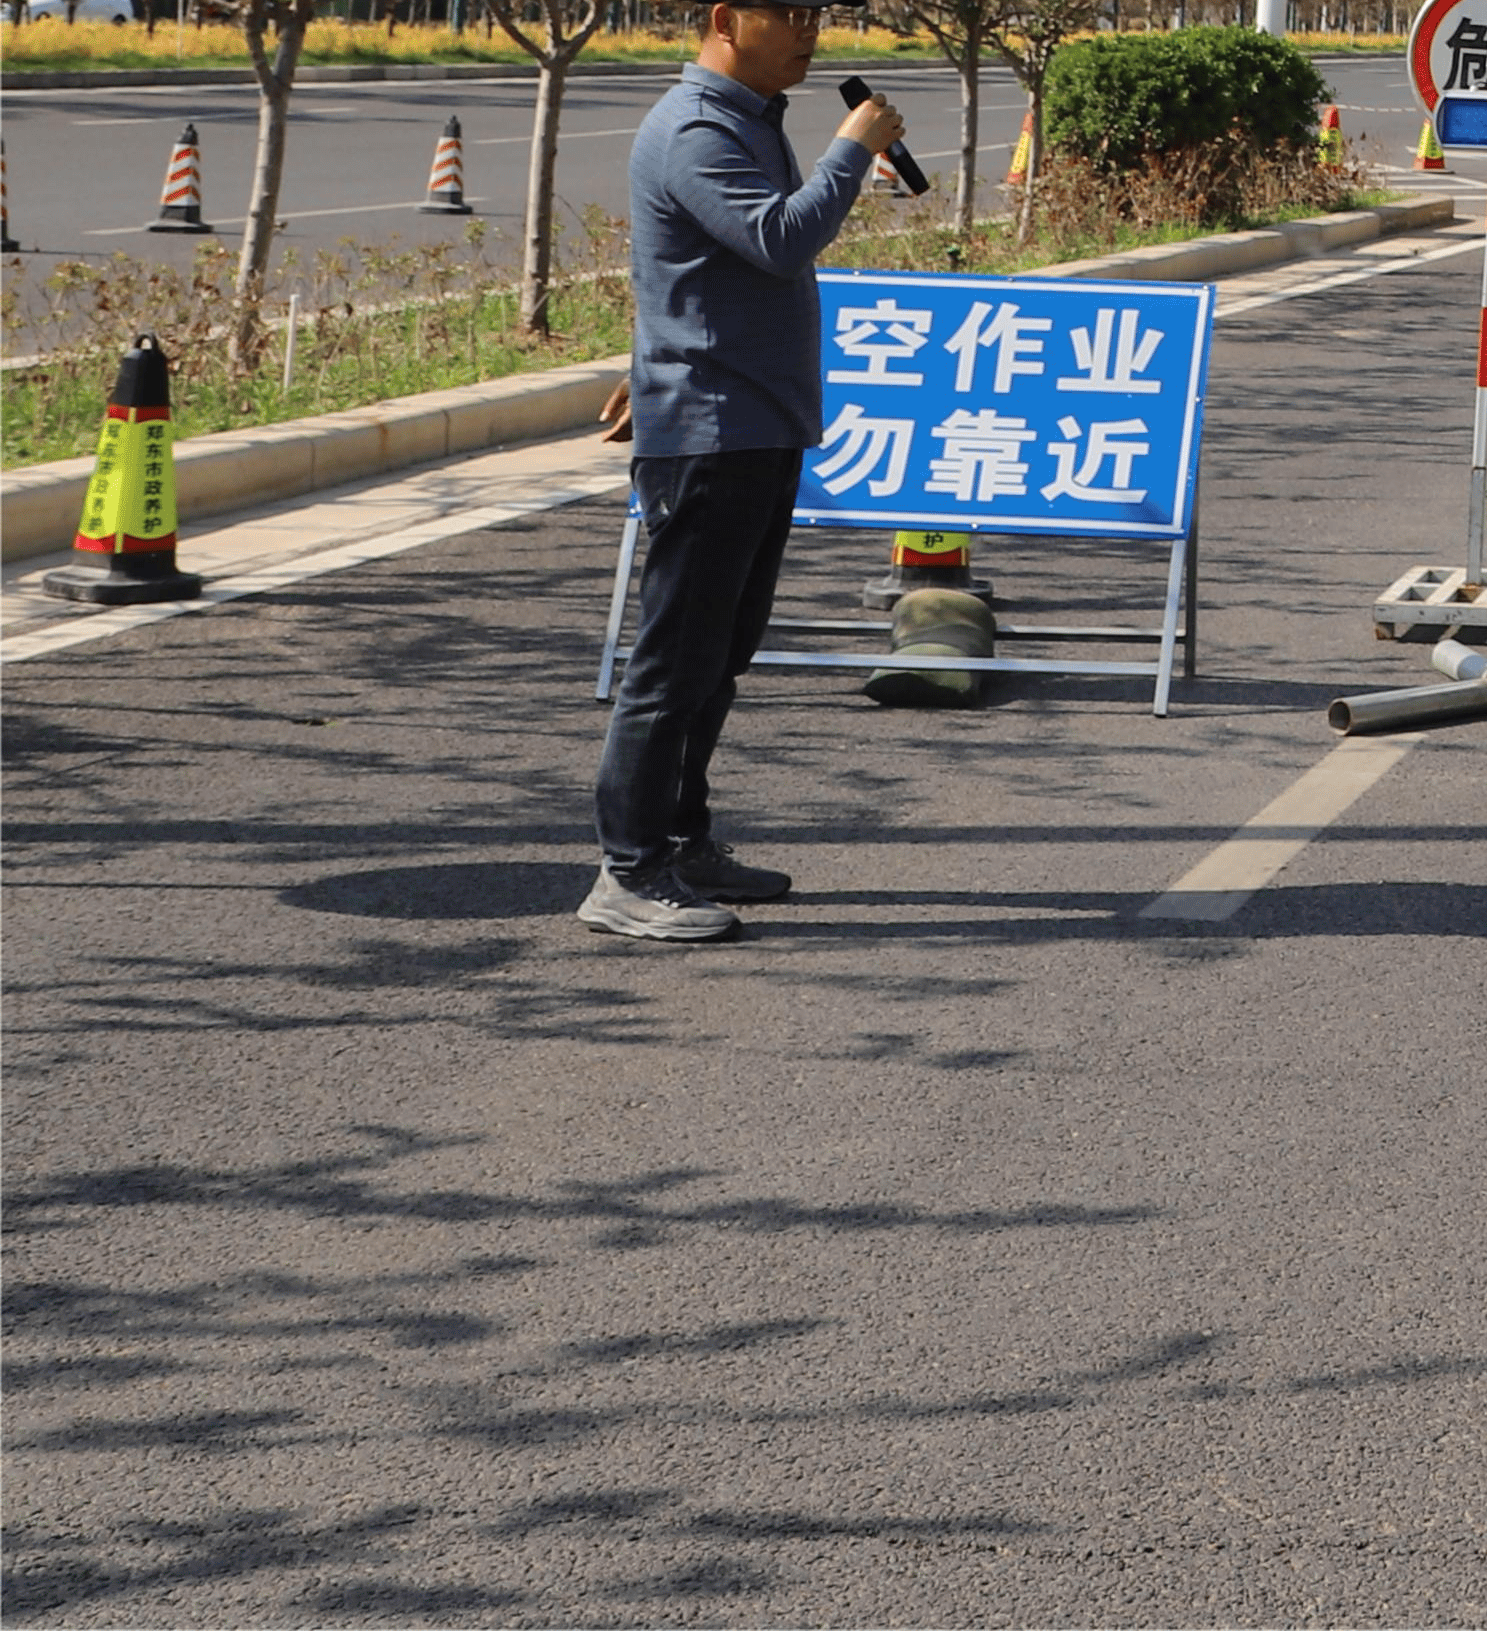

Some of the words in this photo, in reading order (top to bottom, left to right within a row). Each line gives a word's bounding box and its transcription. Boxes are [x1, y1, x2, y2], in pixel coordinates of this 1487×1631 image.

[827, 299, 1165, 394] 空作业
[143, 424, 165, 534] 郑东市政养护
[811, 403, 1151, 505] 勿靠近
[923, 531, 944, 548] 护
